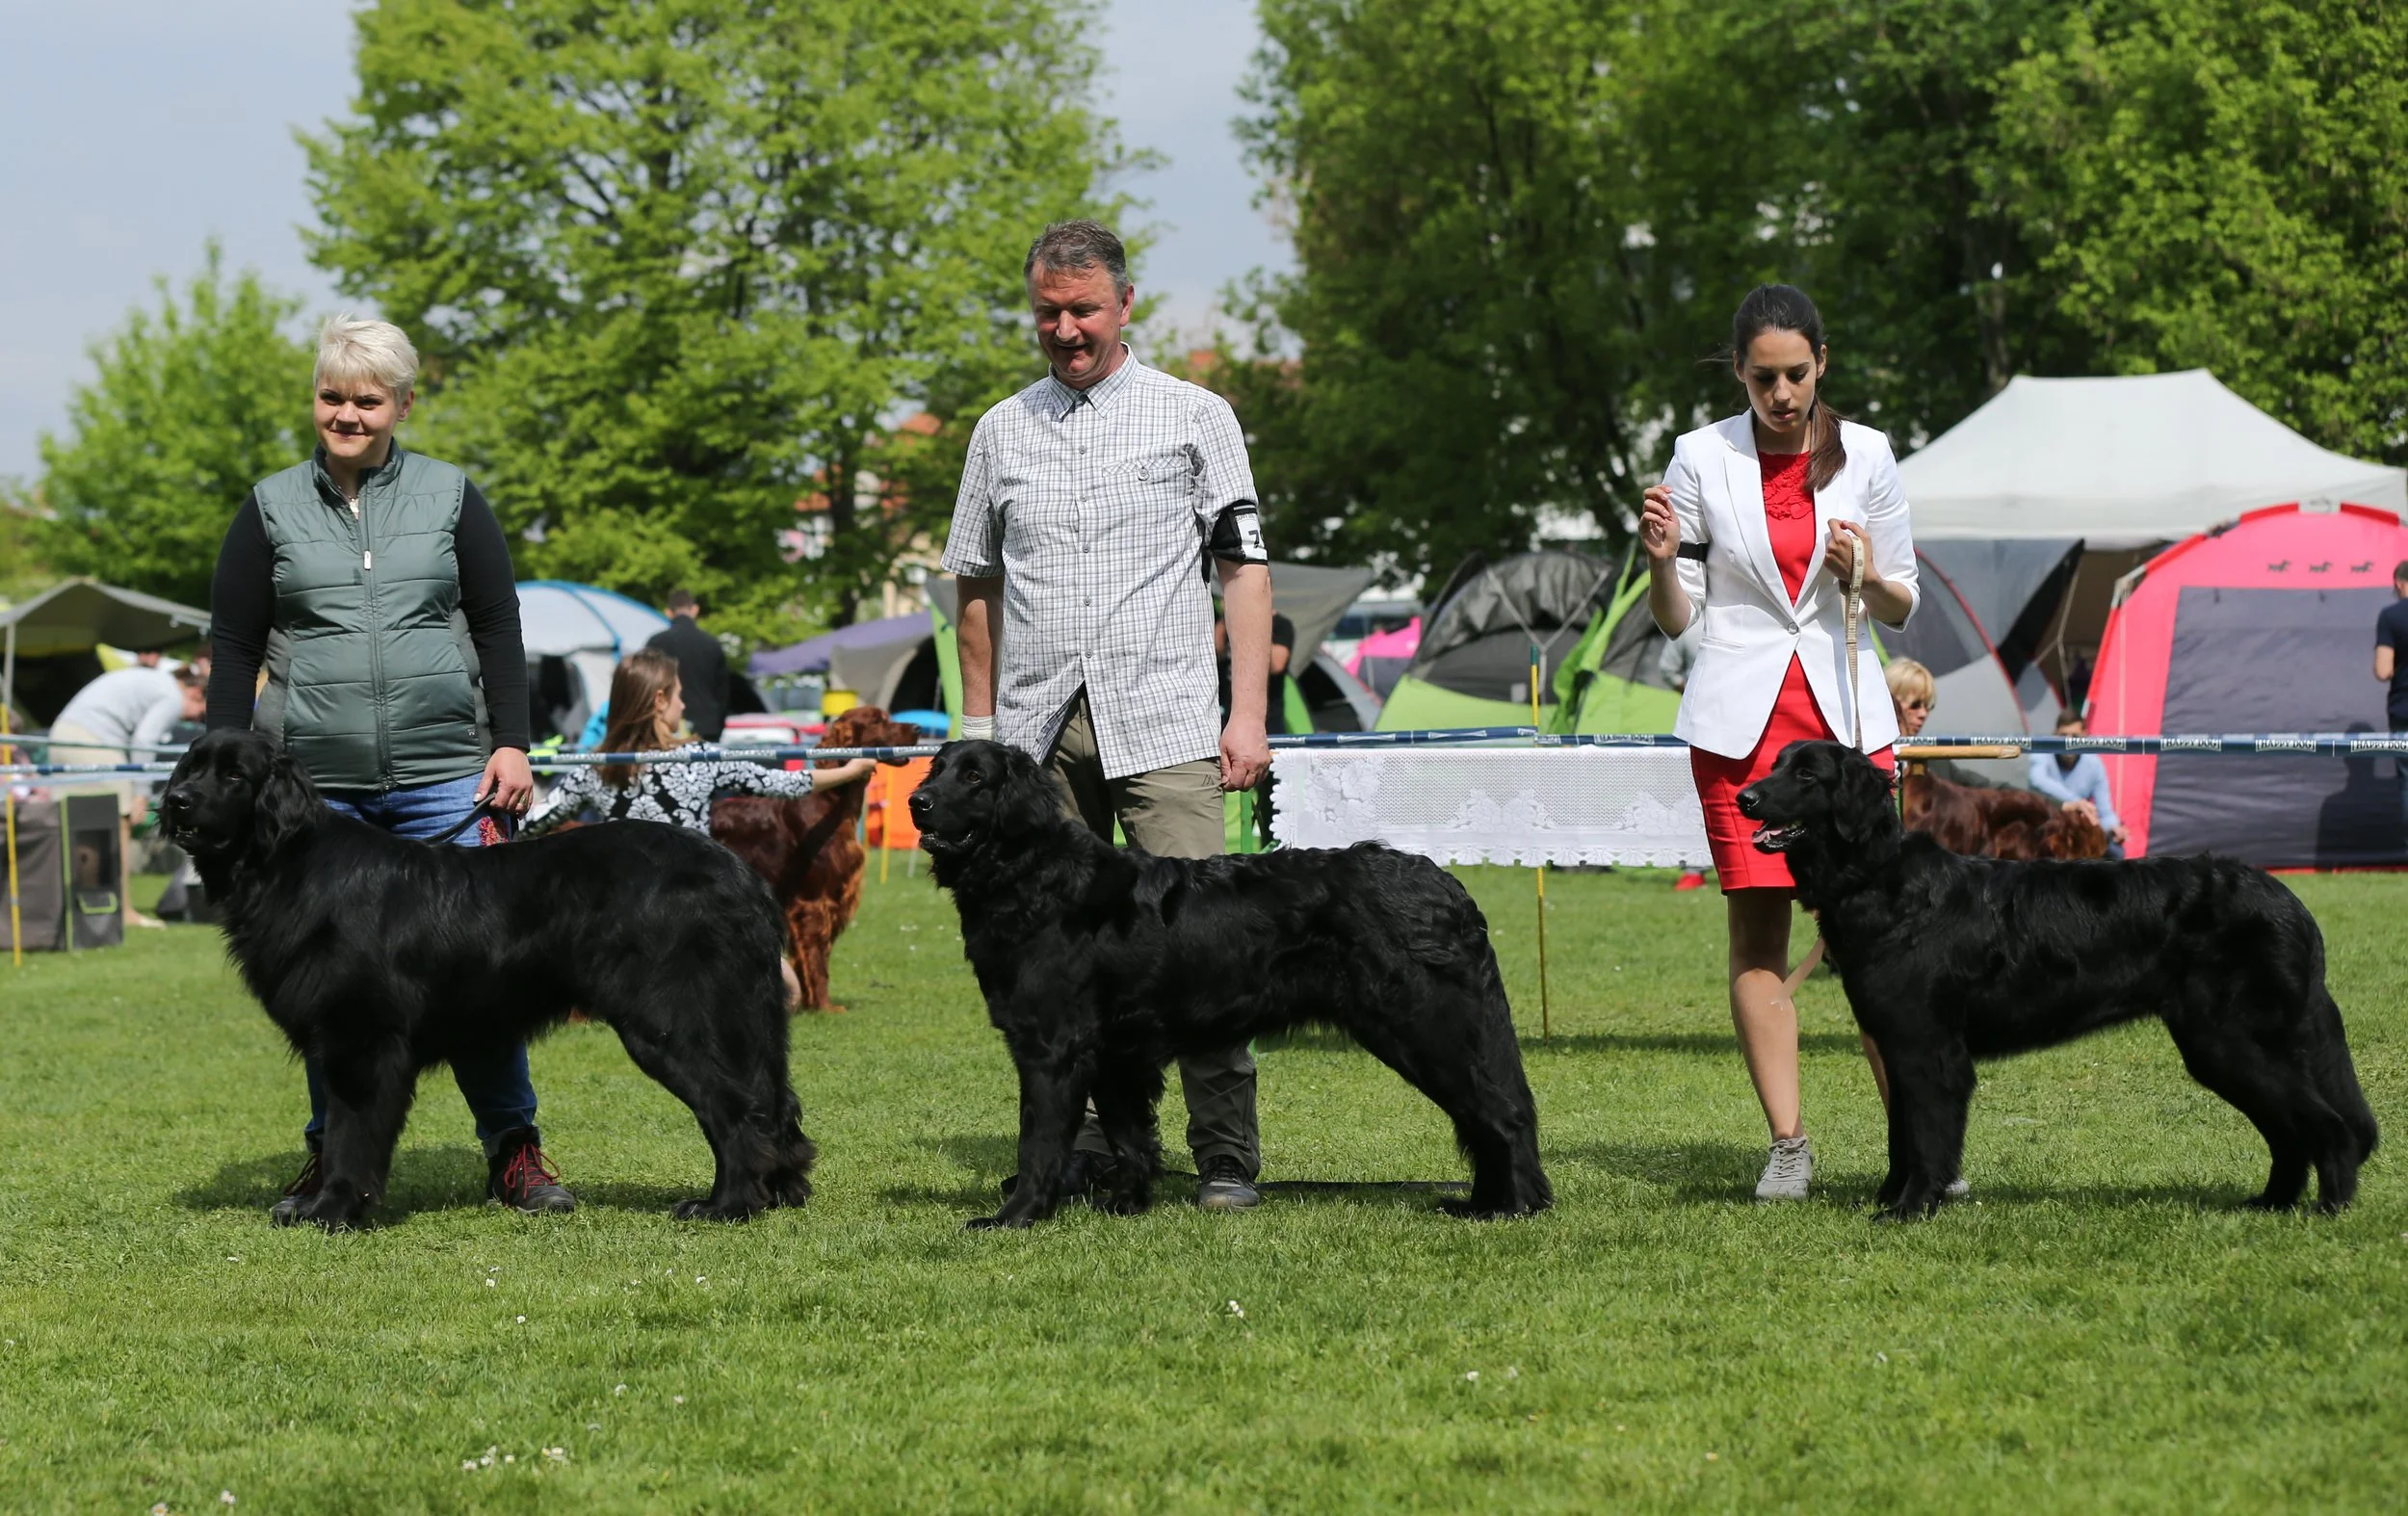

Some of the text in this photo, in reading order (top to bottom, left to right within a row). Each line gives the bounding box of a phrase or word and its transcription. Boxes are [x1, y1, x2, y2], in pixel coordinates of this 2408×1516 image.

[2166, 739, 2216, 747] HAPPY DOG
[2262, 740, 2312, 748] HAPPY DOG
[2356, 740, 2407, 749] HAPPY DOG
